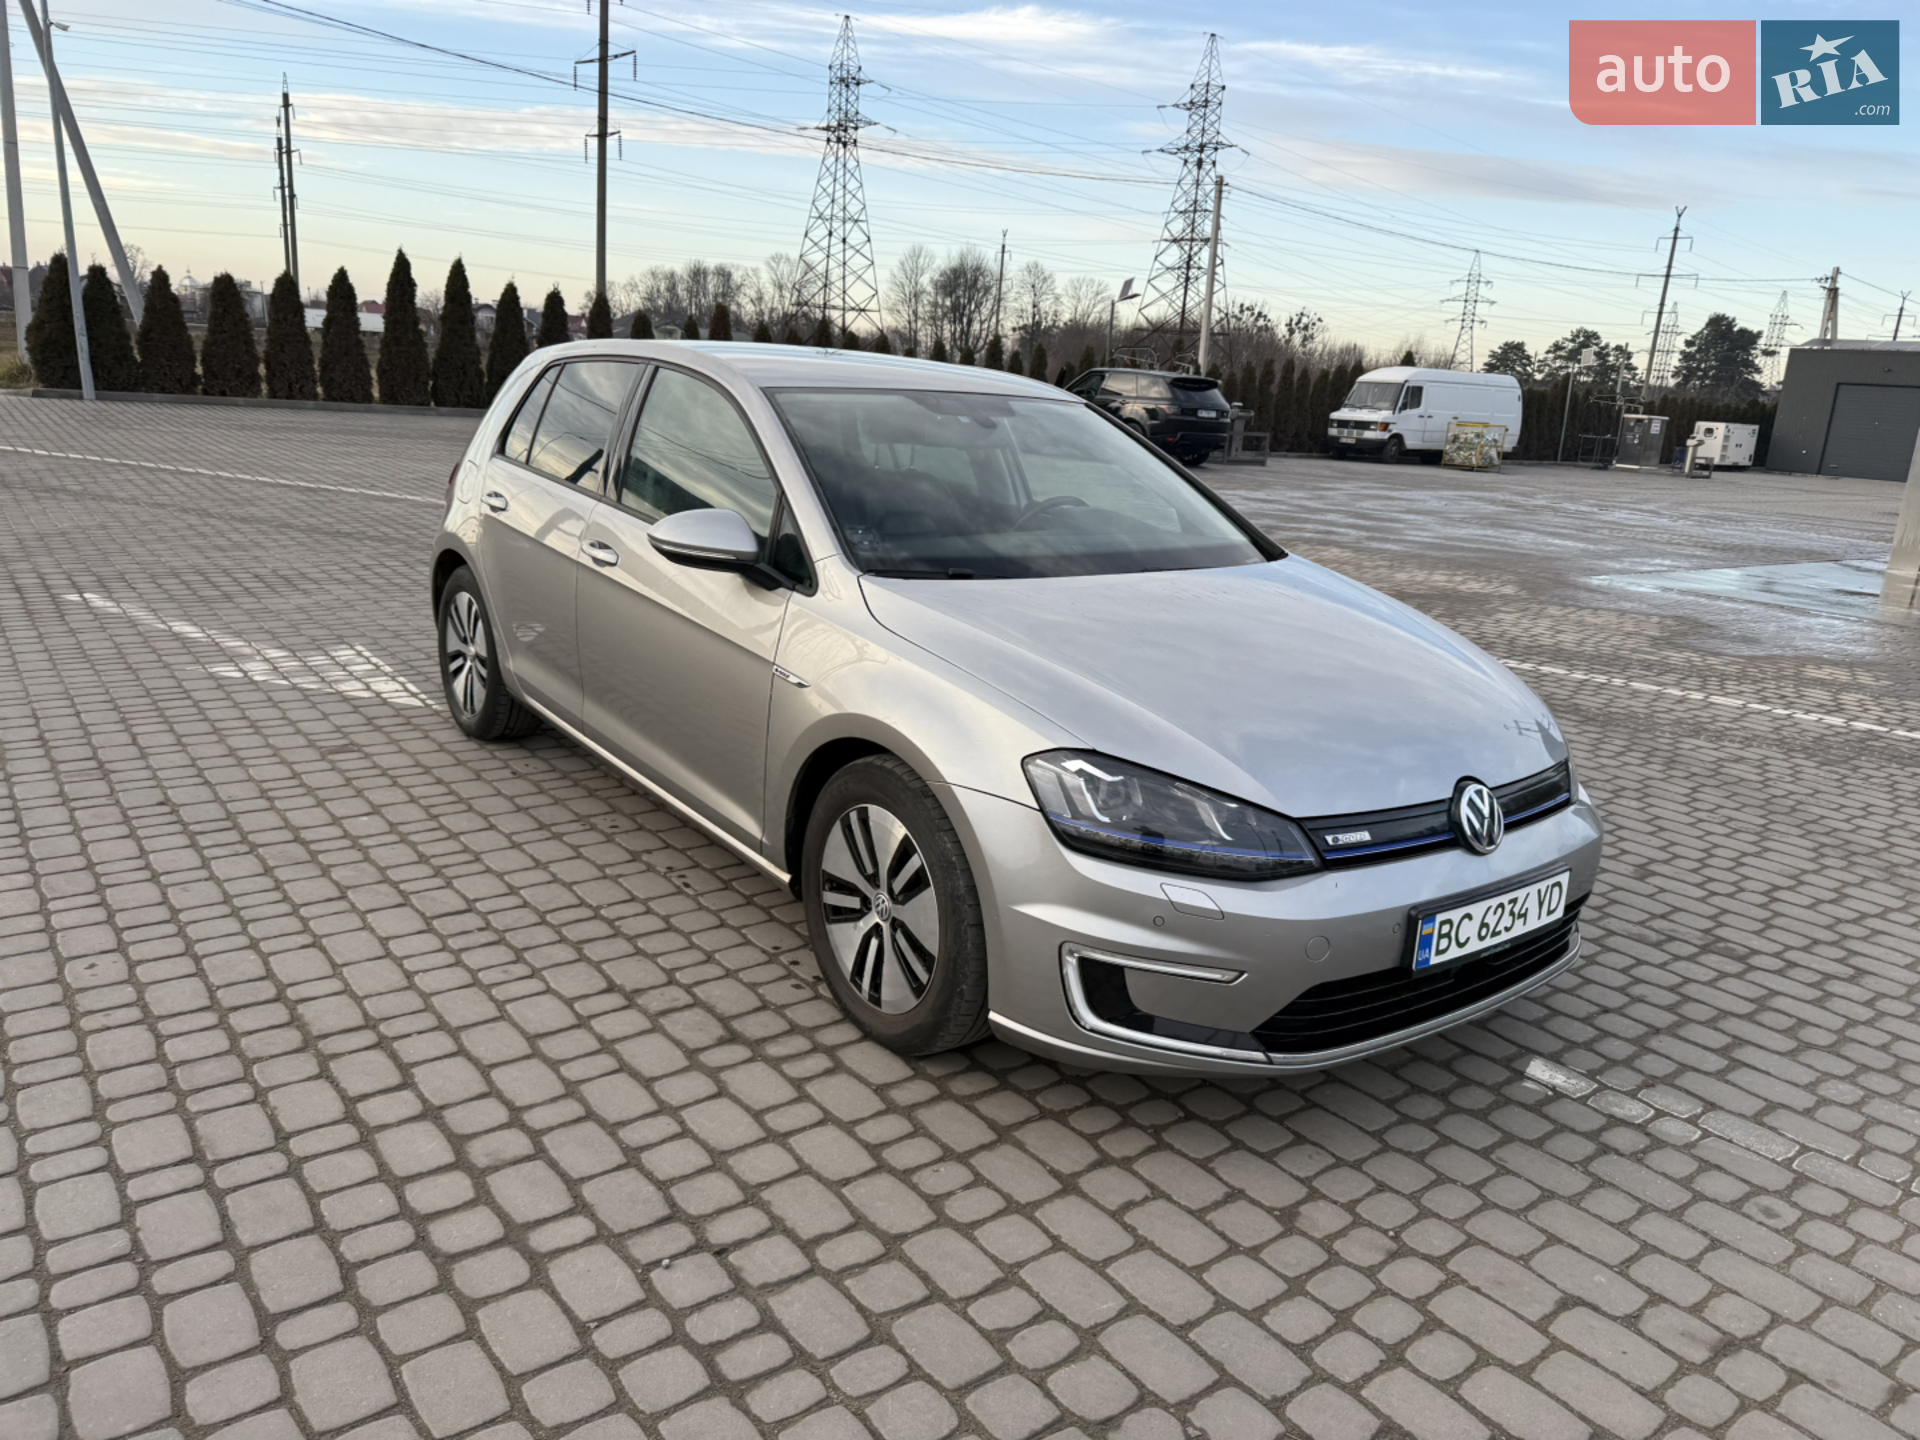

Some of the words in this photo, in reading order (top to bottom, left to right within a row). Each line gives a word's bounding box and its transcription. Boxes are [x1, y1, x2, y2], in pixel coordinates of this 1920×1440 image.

[1434, 912, 1473, 957] BC
[1477, 892, 1531, 942] 6234
[1537, 880, 1563, 921] YD
[1417, 948, 1430, 961] UA
